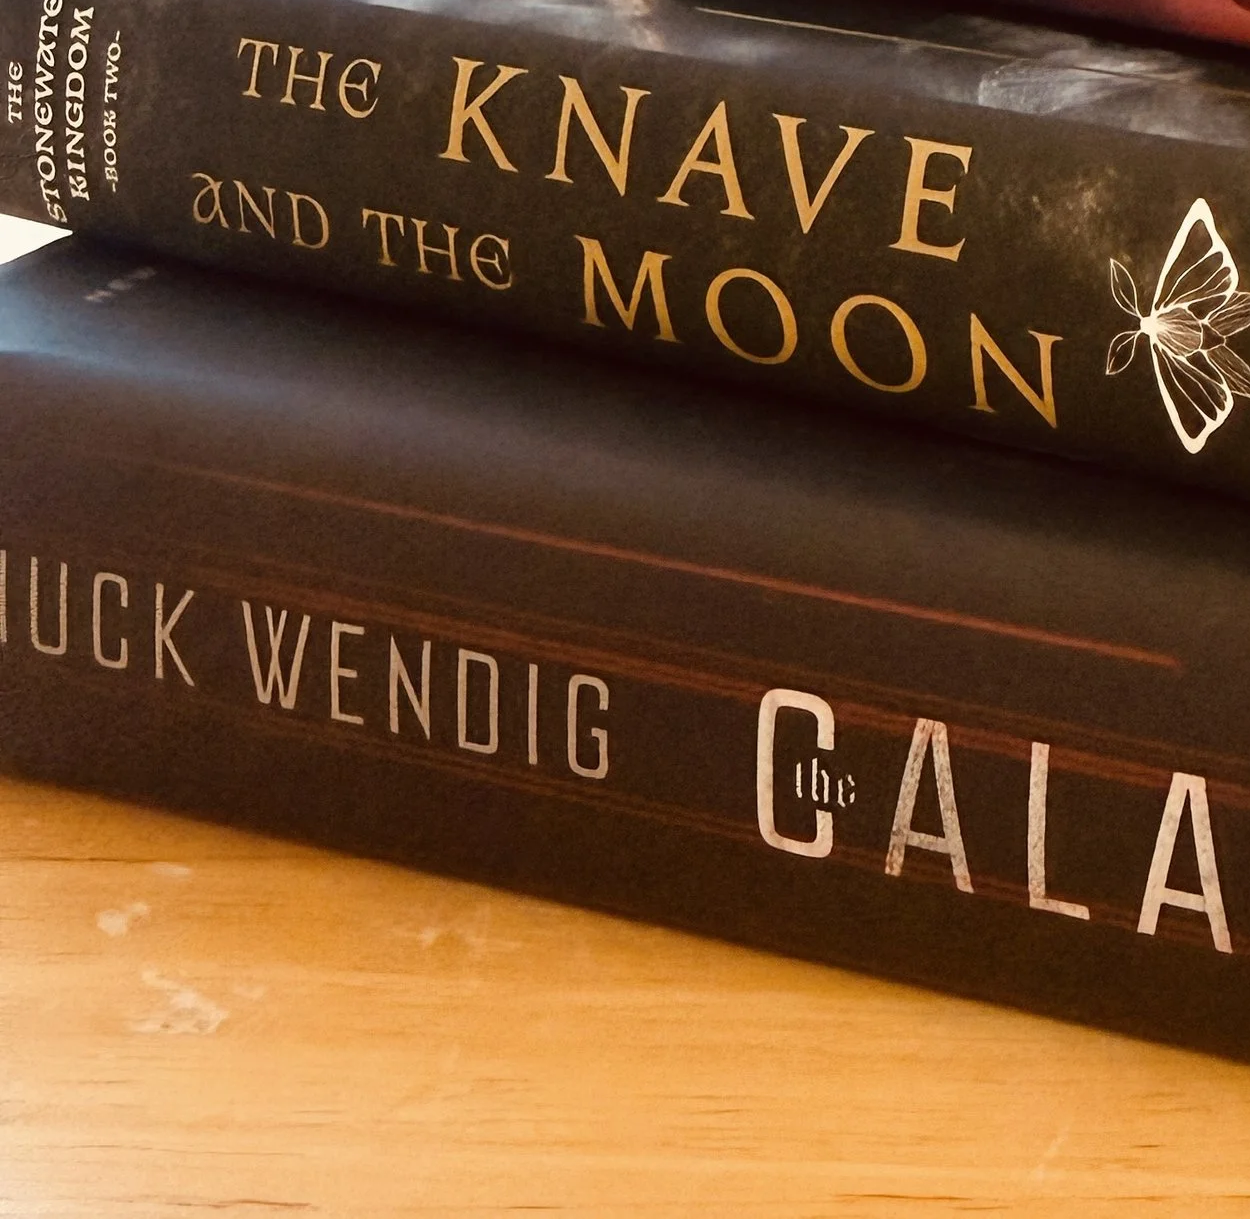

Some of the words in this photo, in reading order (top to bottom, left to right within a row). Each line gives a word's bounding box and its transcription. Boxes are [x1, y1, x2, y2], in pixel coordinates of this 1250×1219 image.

[7, 61, 24, 124] THE
[65, 5, 95, 202] KINGDOM
[237, 38, 382, 119] THE
[438, 56, 974, 263] KNAVE
[361, 208, 513, 290] THE
[573, 234, 1064, 429] MOON
[0, 549, 196, 687] UCK
[242, 600, 610, 780] WENDIG
